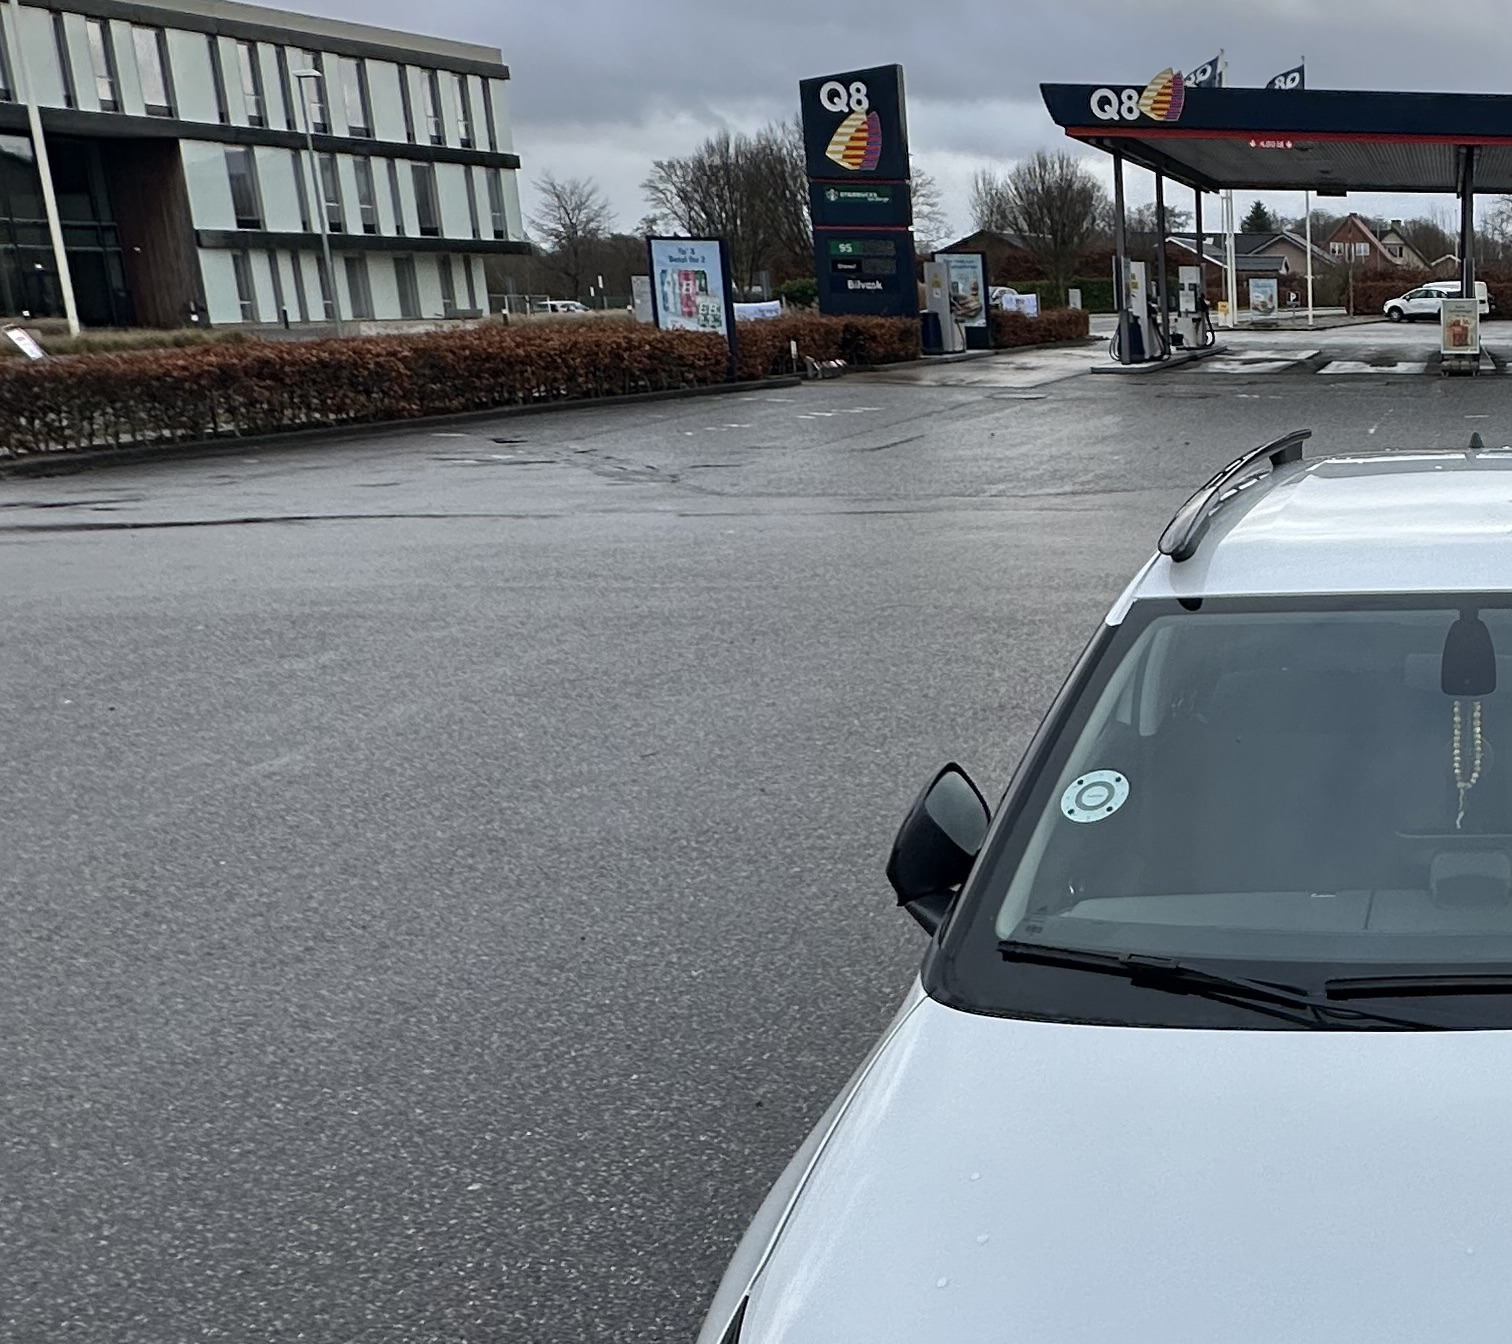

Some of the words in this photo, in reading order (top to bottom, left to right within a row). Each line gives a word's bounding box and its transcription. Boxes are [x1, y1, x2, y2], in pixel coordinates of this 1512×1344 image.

[820, 80, 869, 113] Q8
[1090, 87, 1141, 121] Q8
[847, 279, 883, 289] Bilvask
[1290, 292, 1297, 302] P
